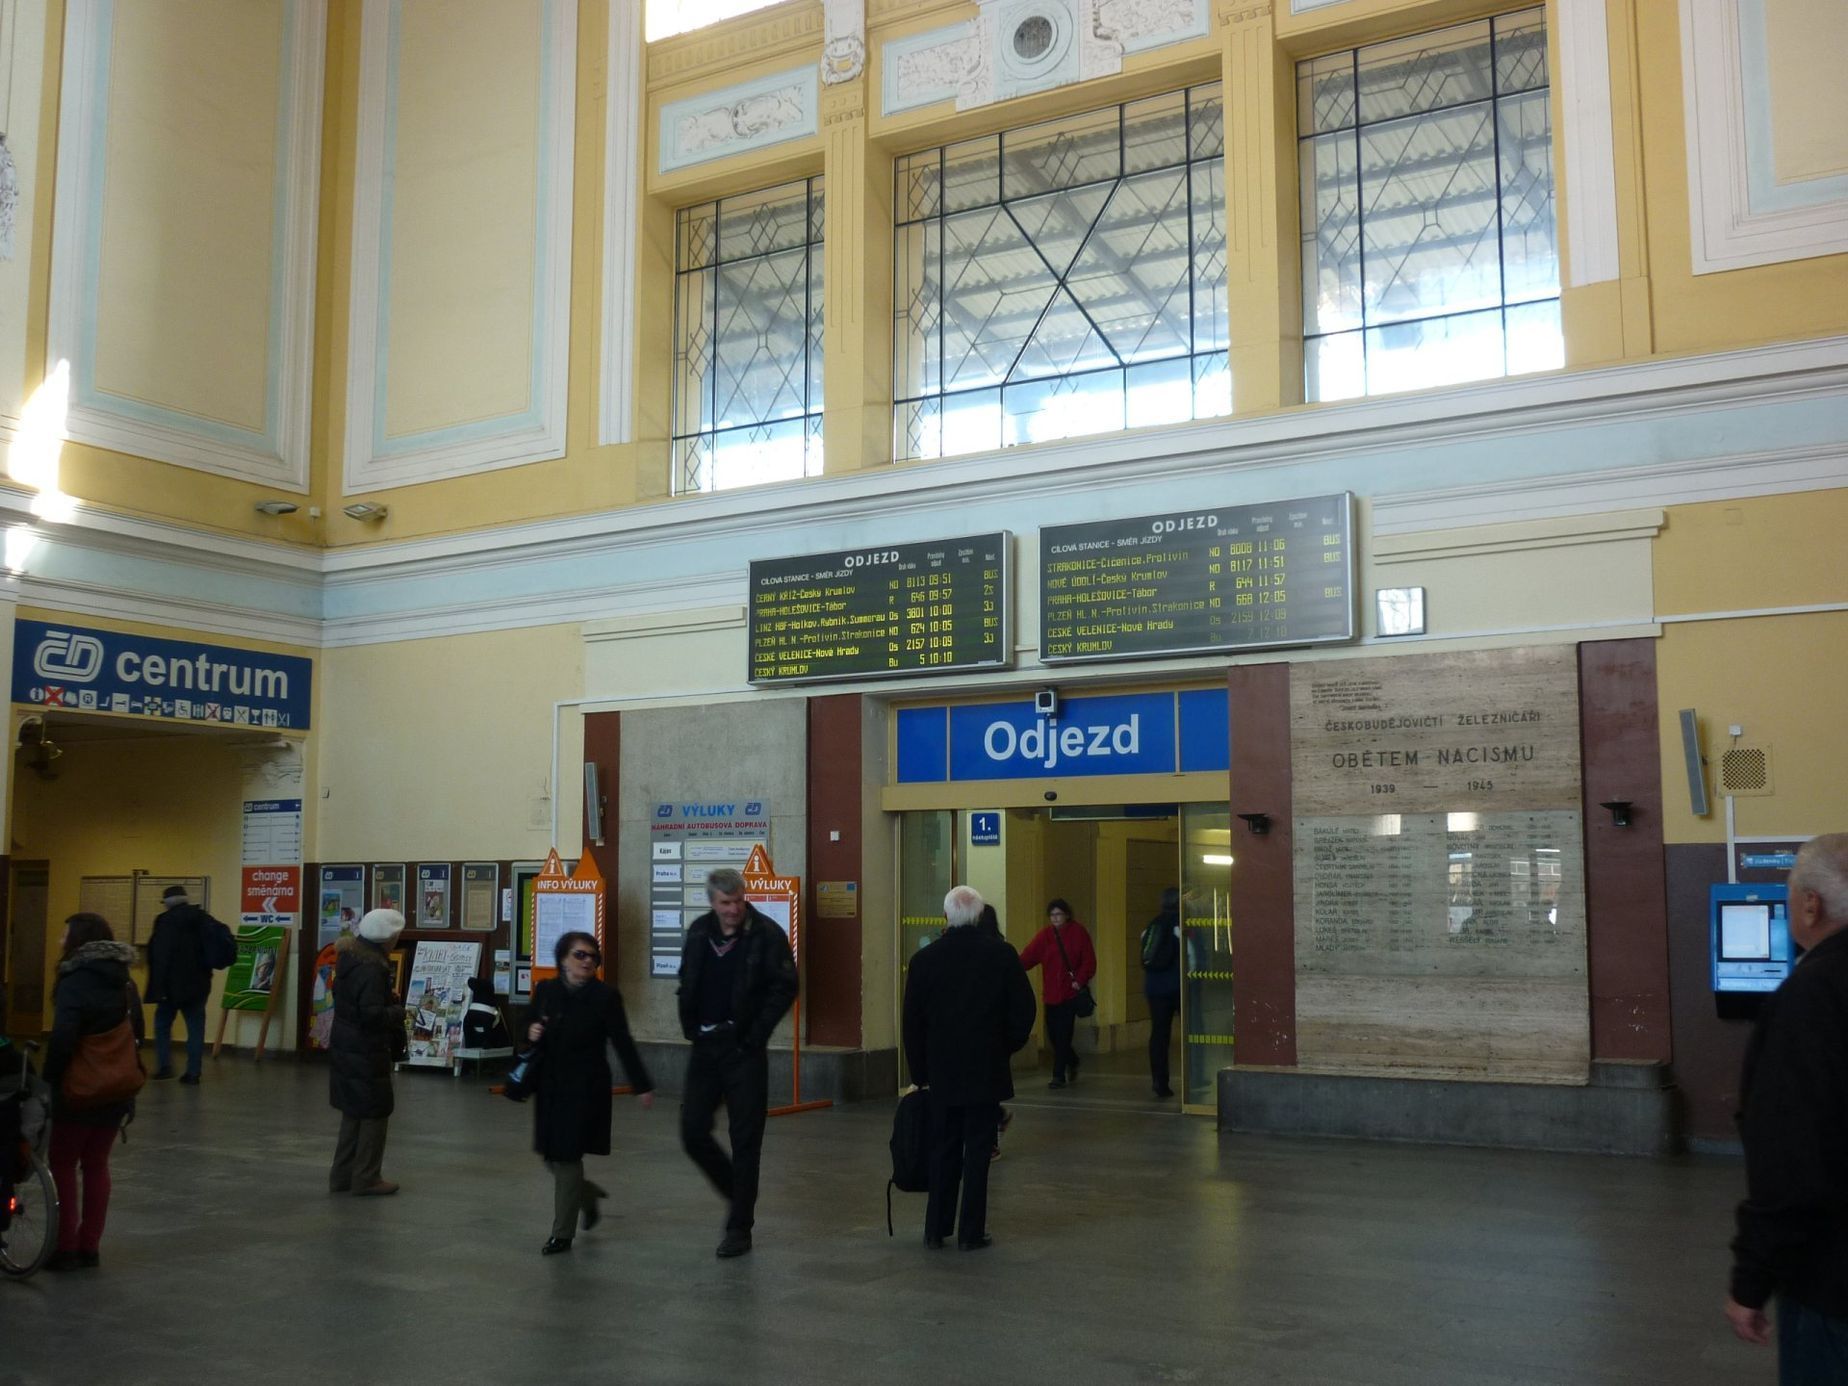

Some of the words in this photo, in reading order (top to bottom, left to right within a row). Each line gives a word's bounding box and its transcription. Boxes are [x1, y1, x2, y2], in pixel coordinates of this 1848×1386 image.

[1152, 515, 1218, 533] ODJEZD
[1079, 540, 1110, 551] STANICE
[844, 551, 900, 568] ODJEZD
[1131, 570, 1168, 582] Krumlov
[1230, 559, 1252, 572] 8117
[1259, 556, 1284, 569] 11:51
[784, 573, 810, 583] STANICE
[1209, 581, 1216, 591] R
[1236, 576, 1253, 589] 644
[1259, 573, 1286, 587] 11:57
[825, 586, 856, 597] Krumlov
[1259, 590, 1286, 604] 12:05
[755, 623, 772, 633] LINZ
[906, 607, 924, 619] 3801
[929, 604, 952, 617] 10:00
[1147, 620, 1174, 631] Hrady
[911, 623, 925, 634] 624
[929, 619, 952, 632] 10:05
[837, 646, 860, 656] Hrady
[906, 638, 925, 651] 2157
[929, 635, 952, 648] 10:09
[1077, 641, 1112, 653] KRUMLOV
[778, 664, 809, 676] KRUMLOV
[919, 653, 925, 665] 5
[929, 651, 952, 664] 10:10
[115, 652, 289, 699] centrum
[983, 713, 1139, 768] Odjezd
[1332, 748, 1419, 769] OBĚTEM
[1437, 745, 1535, 766] NACISMU
[1370, 784, 1396, 794] 1939
[1467, 780, 1493, 791] 1945
[682, 801, 735, 817] VÝLUKY
[735, 820, 768, 829] DOPRAVA
[252, 869, 289, 883] change
[537, 880, 559, 890] INFO
[560, 877, 598, 890] VÝLUKY
[750, 877, 792, 890] VÝLUKY
[247, 882, 294, 897] směnárna
[261, 914, 274, 923] WC
